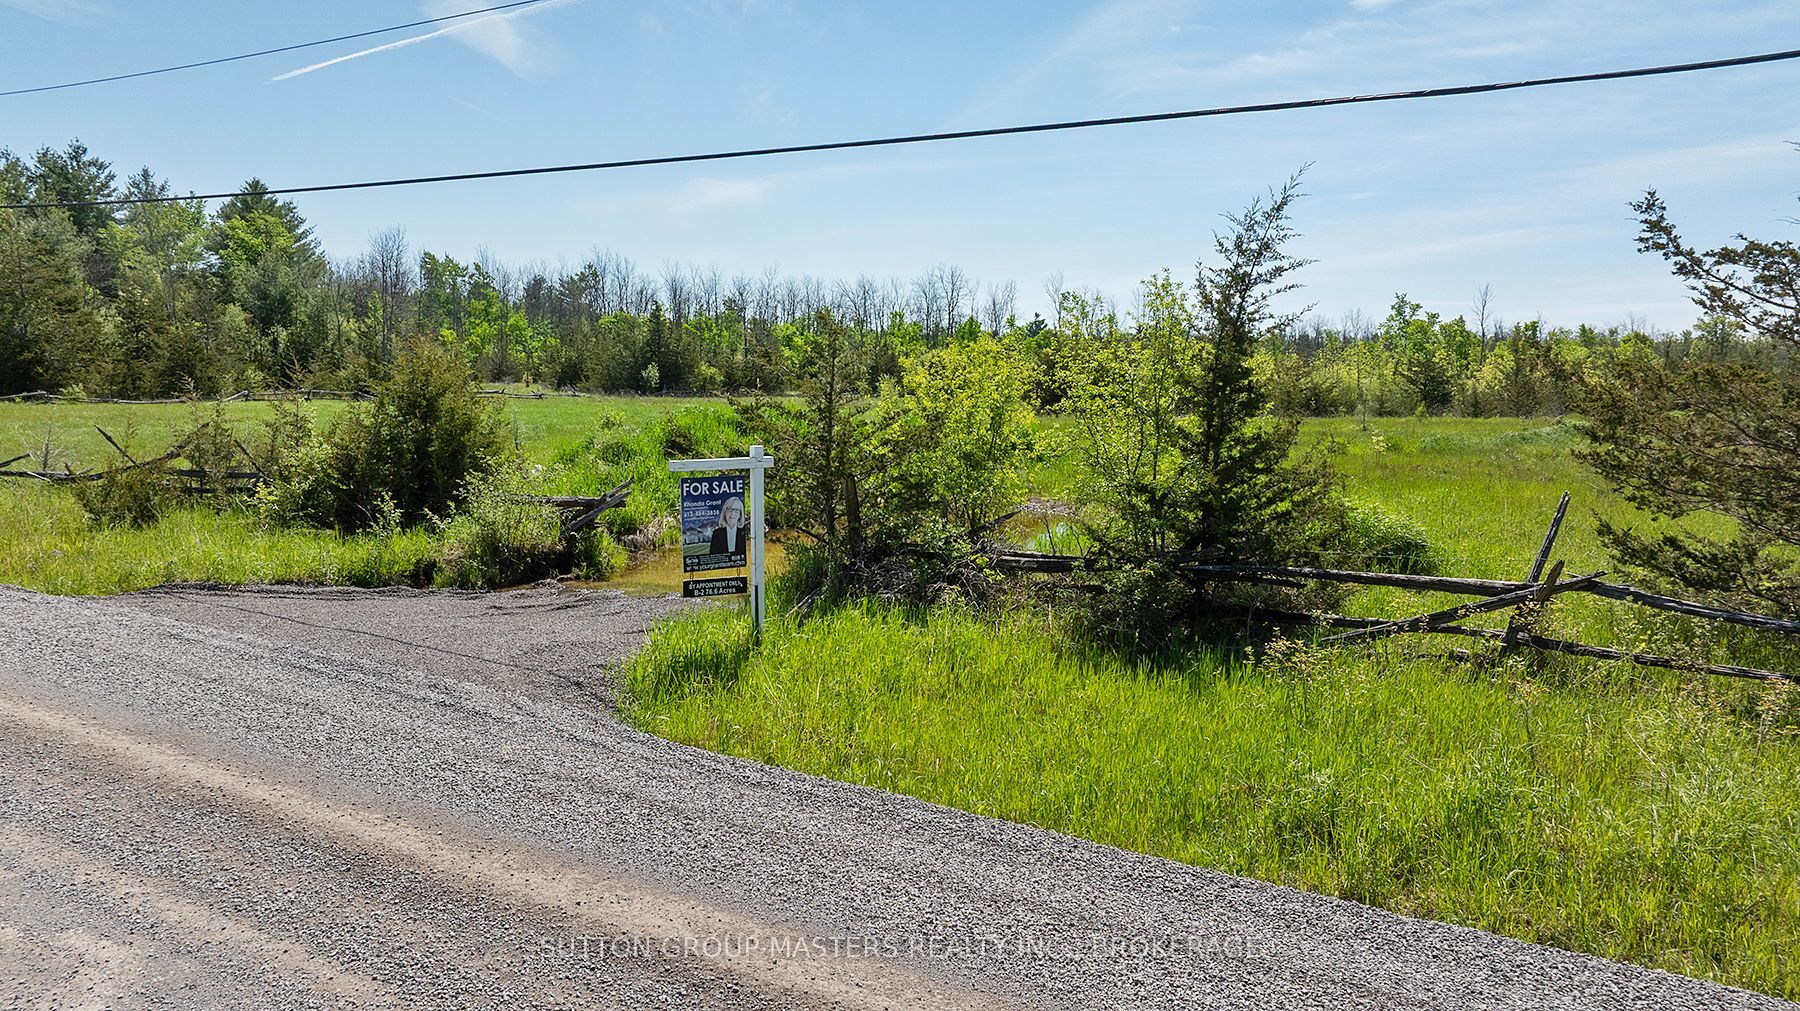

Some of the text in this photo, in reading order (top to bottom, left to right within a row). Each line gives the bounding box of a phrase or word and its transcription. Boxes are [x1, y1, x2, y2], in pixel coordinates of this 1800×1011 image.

[683, 480, 743, 496] FOR SALE
[689, 582, 696, 590] BY
[696, 581, 728, 589] APPOINTMENT
